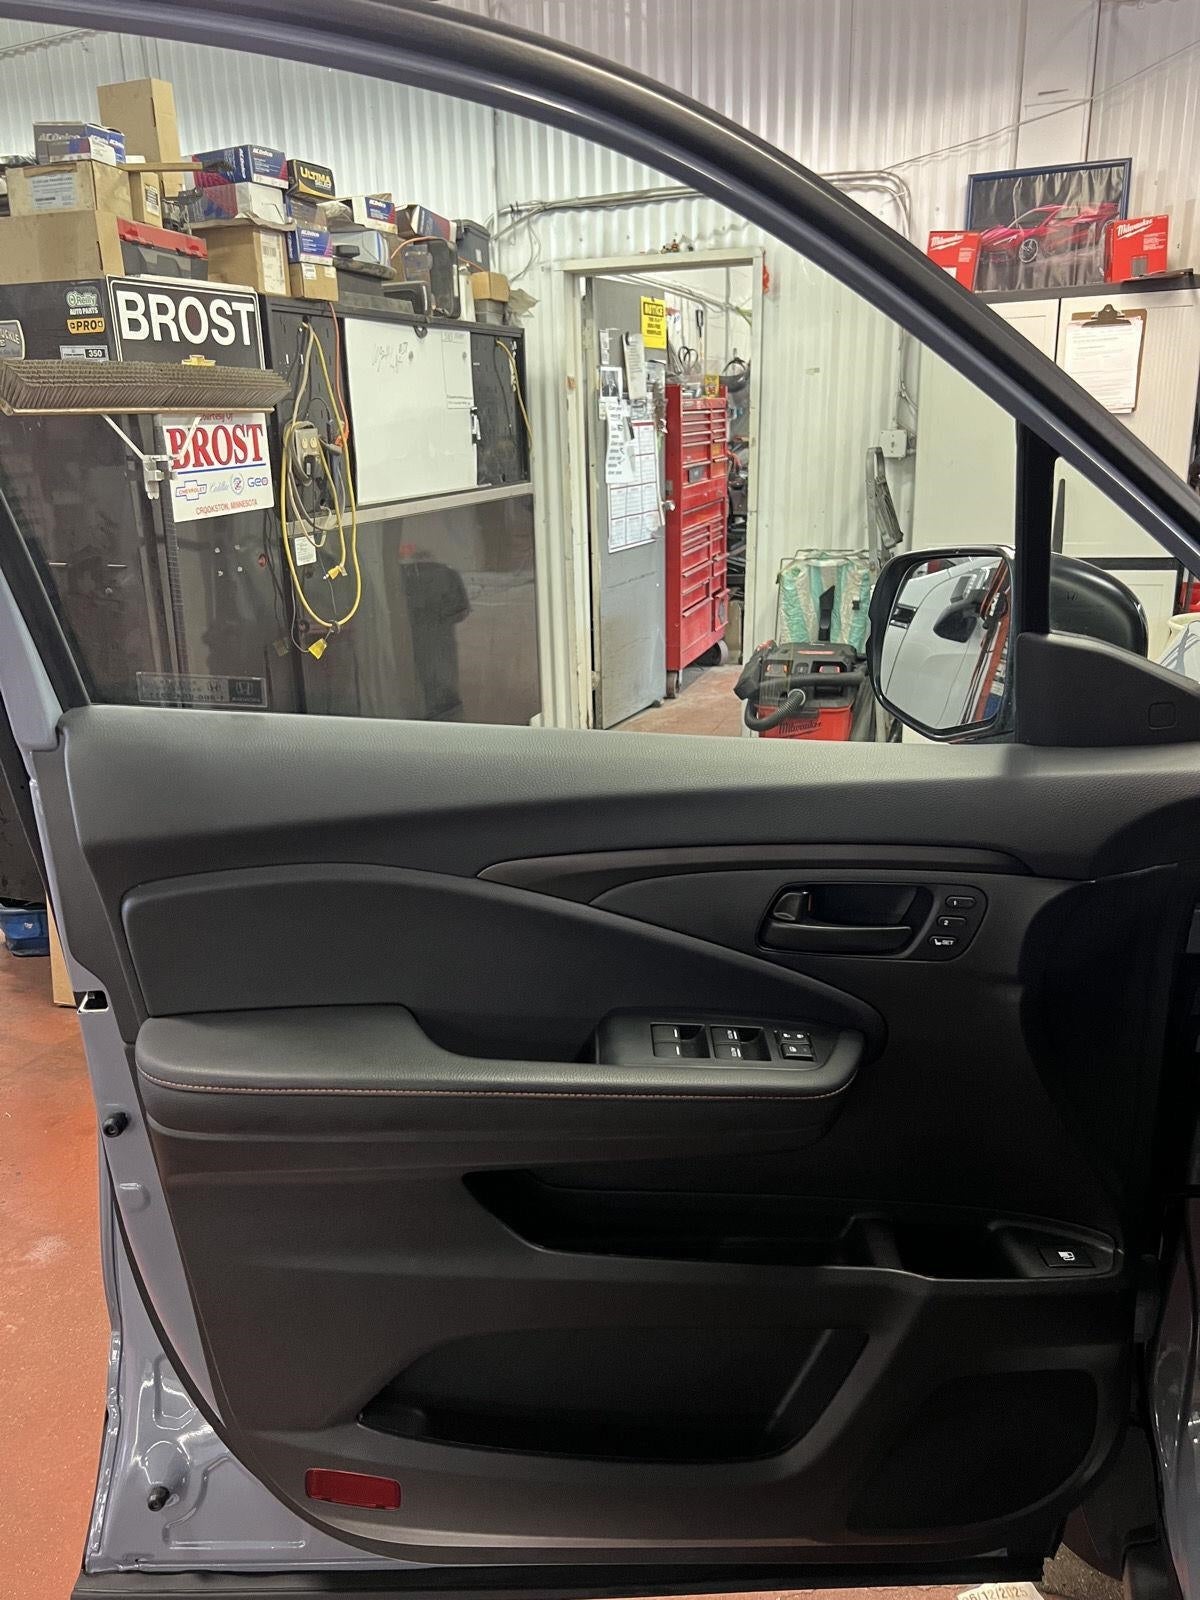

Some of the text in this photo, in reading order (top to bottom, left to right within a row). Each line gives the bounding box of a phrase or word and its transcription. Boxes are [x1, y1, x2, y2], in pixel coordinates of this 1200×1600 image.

[70, 306, 98, 315] AUTO PARTS
[116, 290, 255, 346] BROST
[76, 320, 97, 331] PRO
[88, 349, 103, 358] 350
[166, 424, 263, 469] BROST
